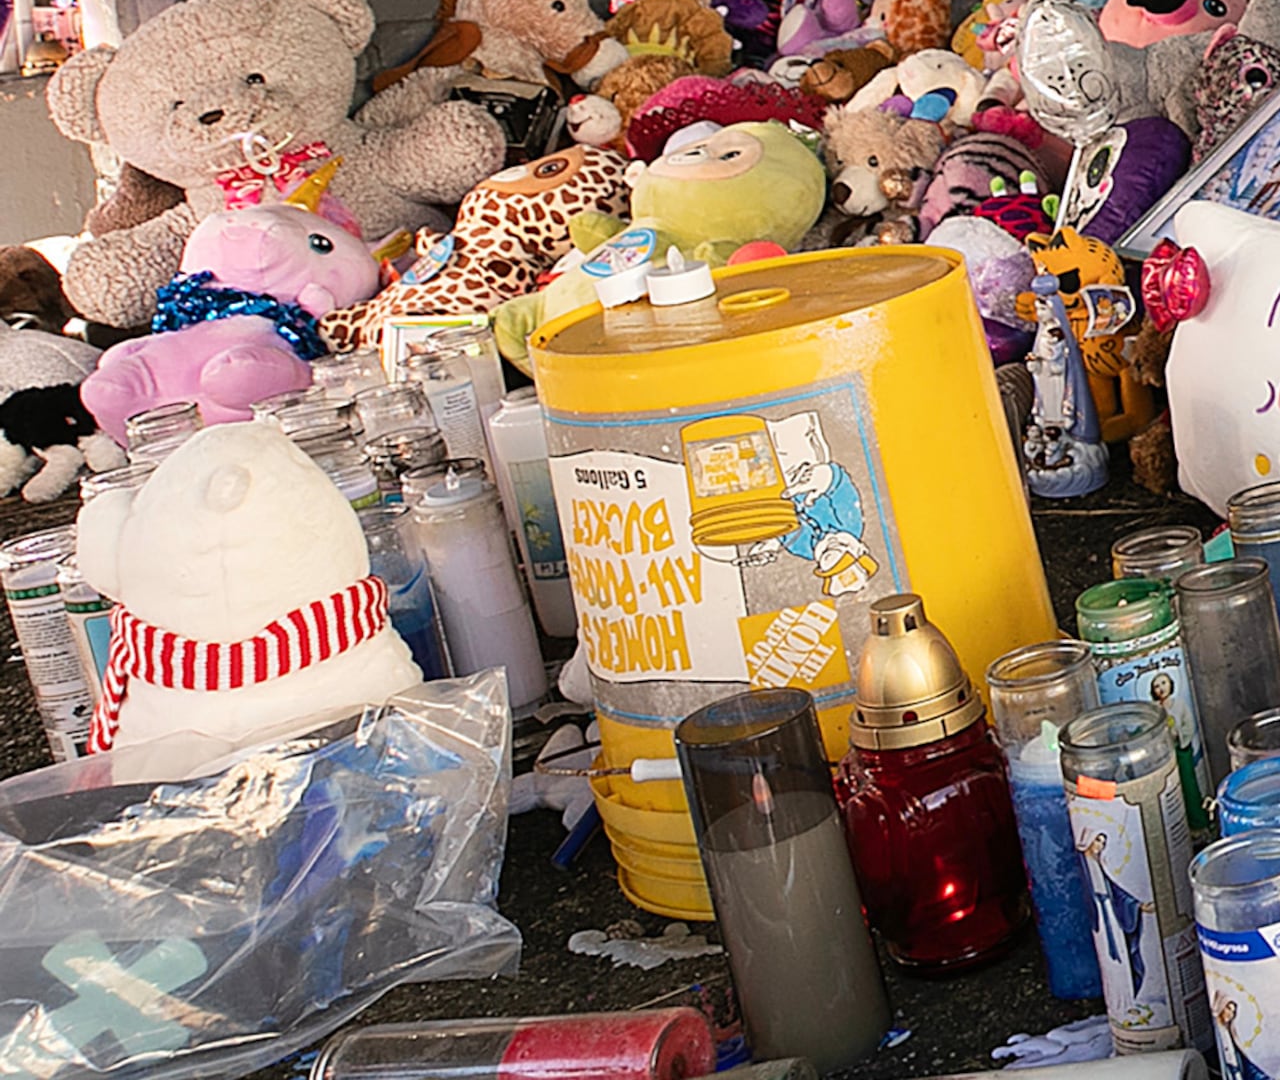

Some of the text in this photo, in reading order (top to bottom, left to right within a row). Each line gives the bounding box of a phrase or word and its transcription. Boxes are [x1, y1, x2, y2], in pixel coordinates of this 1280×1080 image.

[574, 468, 647, 490] 5 Gallons
[572, 498, 674, 555] BUCKET
[746, 608, 800, 669] DEPOT
[796, 643, 837, 683] THE
